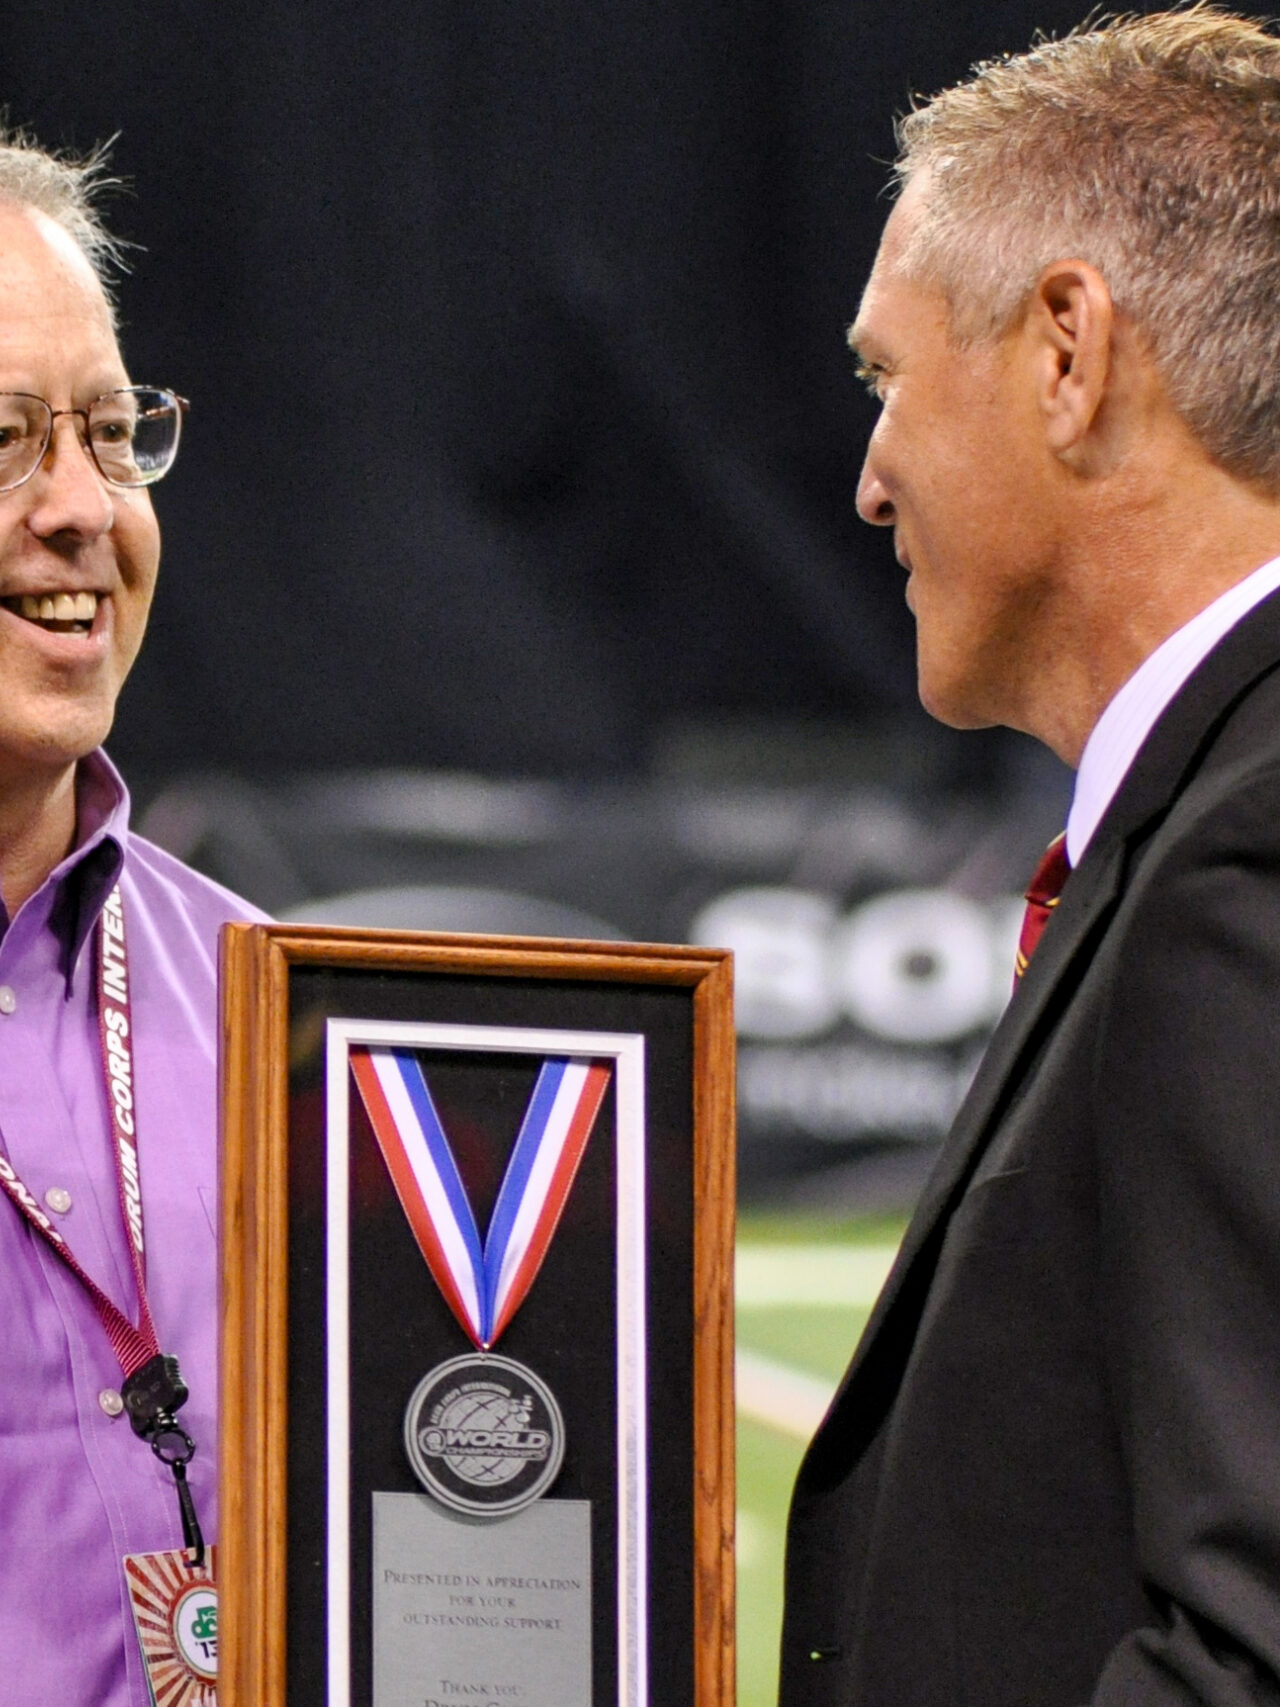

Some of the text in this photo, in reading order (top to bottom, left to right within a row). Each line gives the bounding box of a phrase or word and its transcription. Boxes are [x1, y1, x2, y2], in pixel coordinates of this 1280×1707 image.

[102, 884, 144, 1253] DRUM CORPS INTER
[446, 1430, 547, 1449] WORLD
[383, 1569, 581, 1591] PRESENTED IN APPRECIATION
[449, 1595, 516, 1609] FOR YOUR
[403, 1613, 563, 1631] OUTSTANDING SUPPORT
[440, 1680, 488, 1696] THANK
